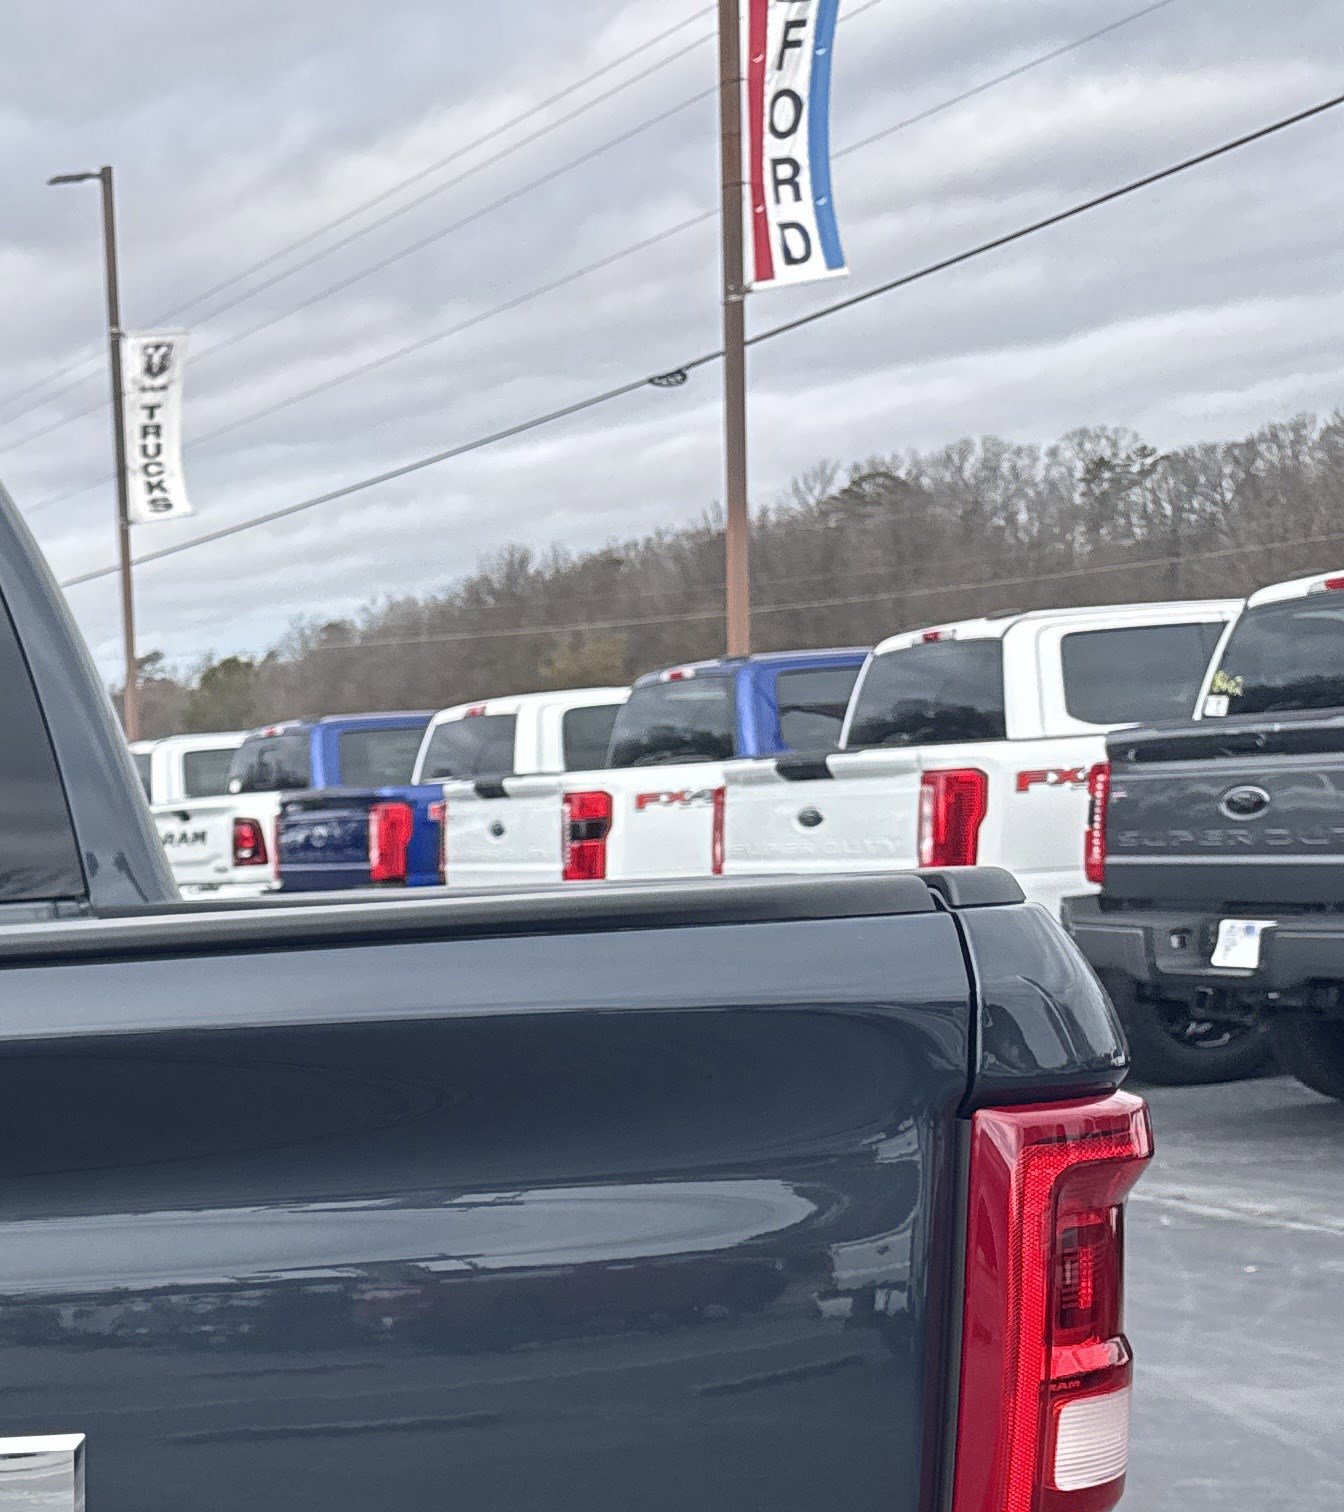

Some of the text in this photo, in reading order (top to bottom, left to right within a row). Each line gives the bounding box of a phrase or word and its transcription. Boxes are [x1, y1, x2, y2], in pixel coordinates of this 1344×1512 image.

[768, 18, 812, 266] FORD
[139, 402, 174, 514] TRUCKS
[162, 830, 208, 847] RAM
